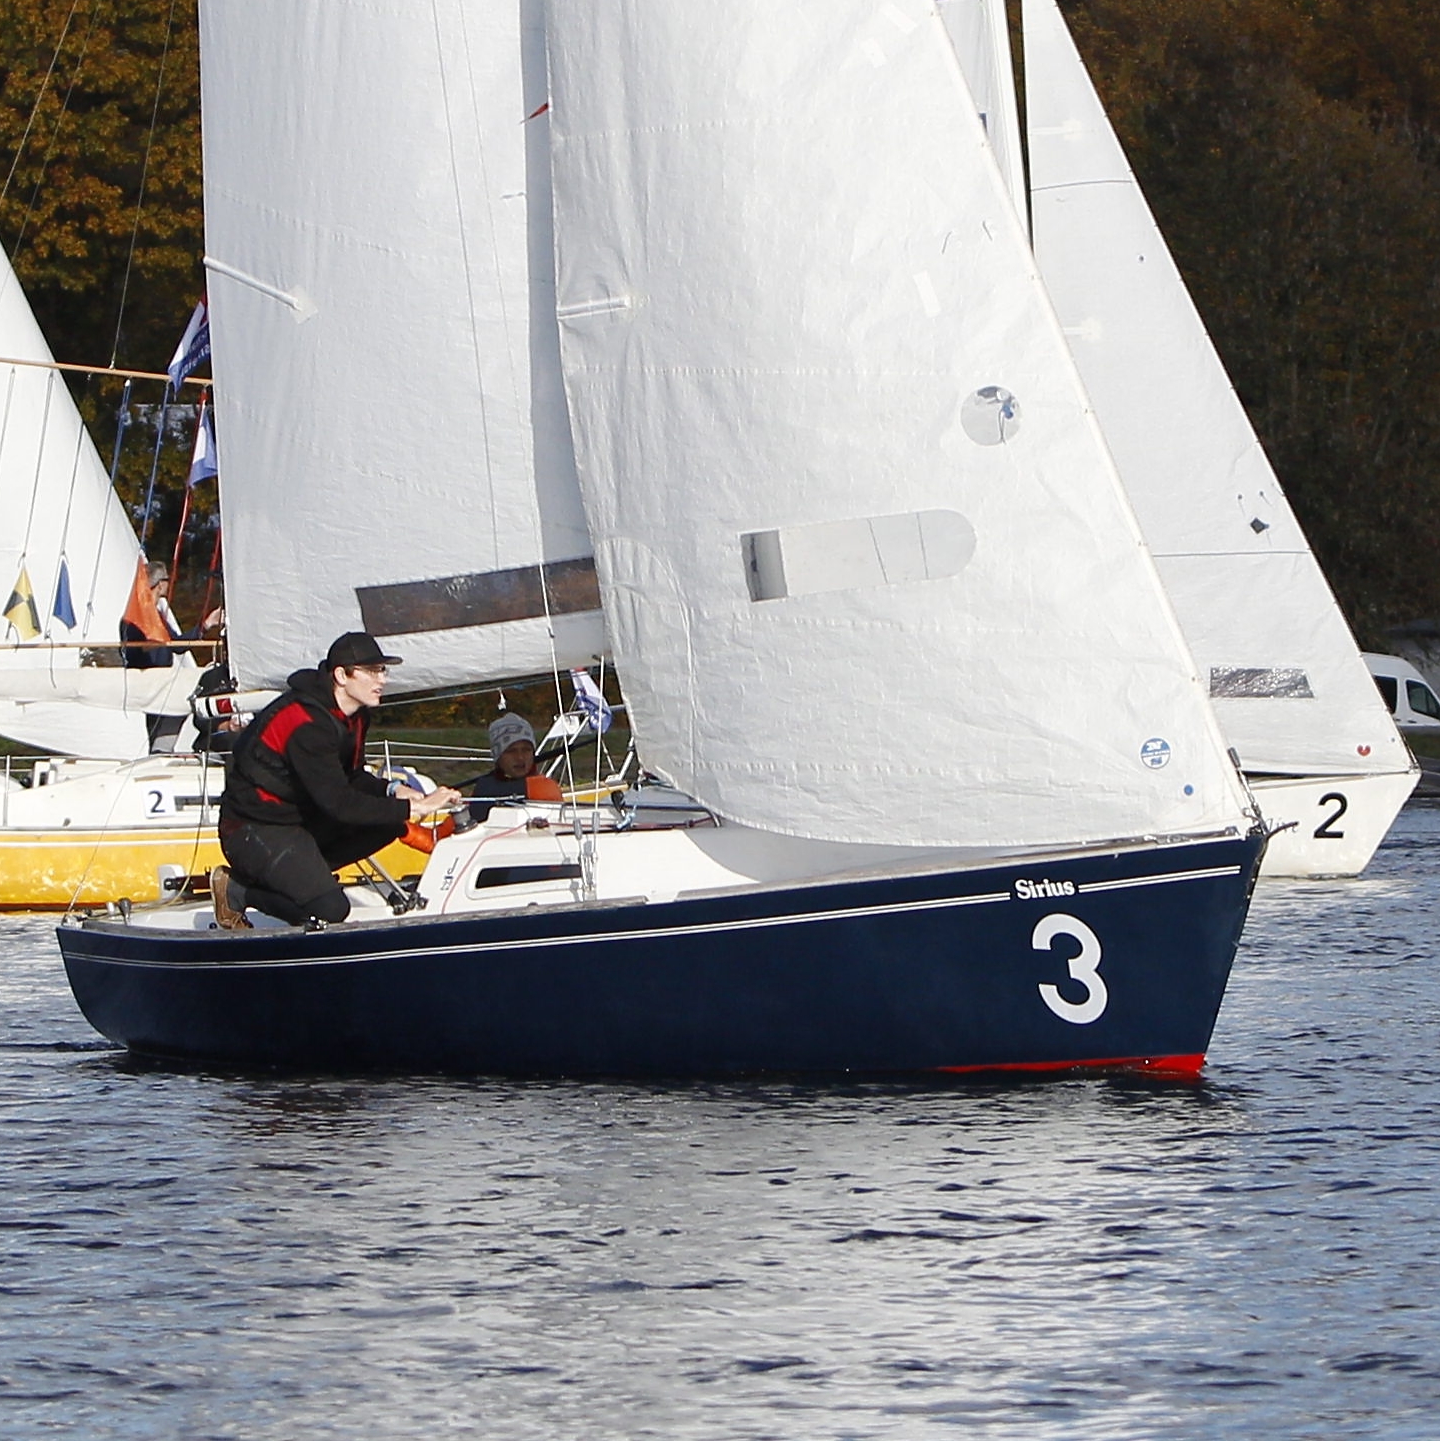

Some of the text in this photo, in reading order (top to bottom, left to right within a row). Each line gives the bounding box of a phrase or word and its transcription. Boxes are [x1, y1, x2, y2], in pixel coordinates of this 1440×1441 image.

[148, 790, 166, 813] 2
[1313, 792, 1348, 839] 2
[1014, 878, 1076, 901] Sirius
[1032, 913, 1108, 1024] 3
